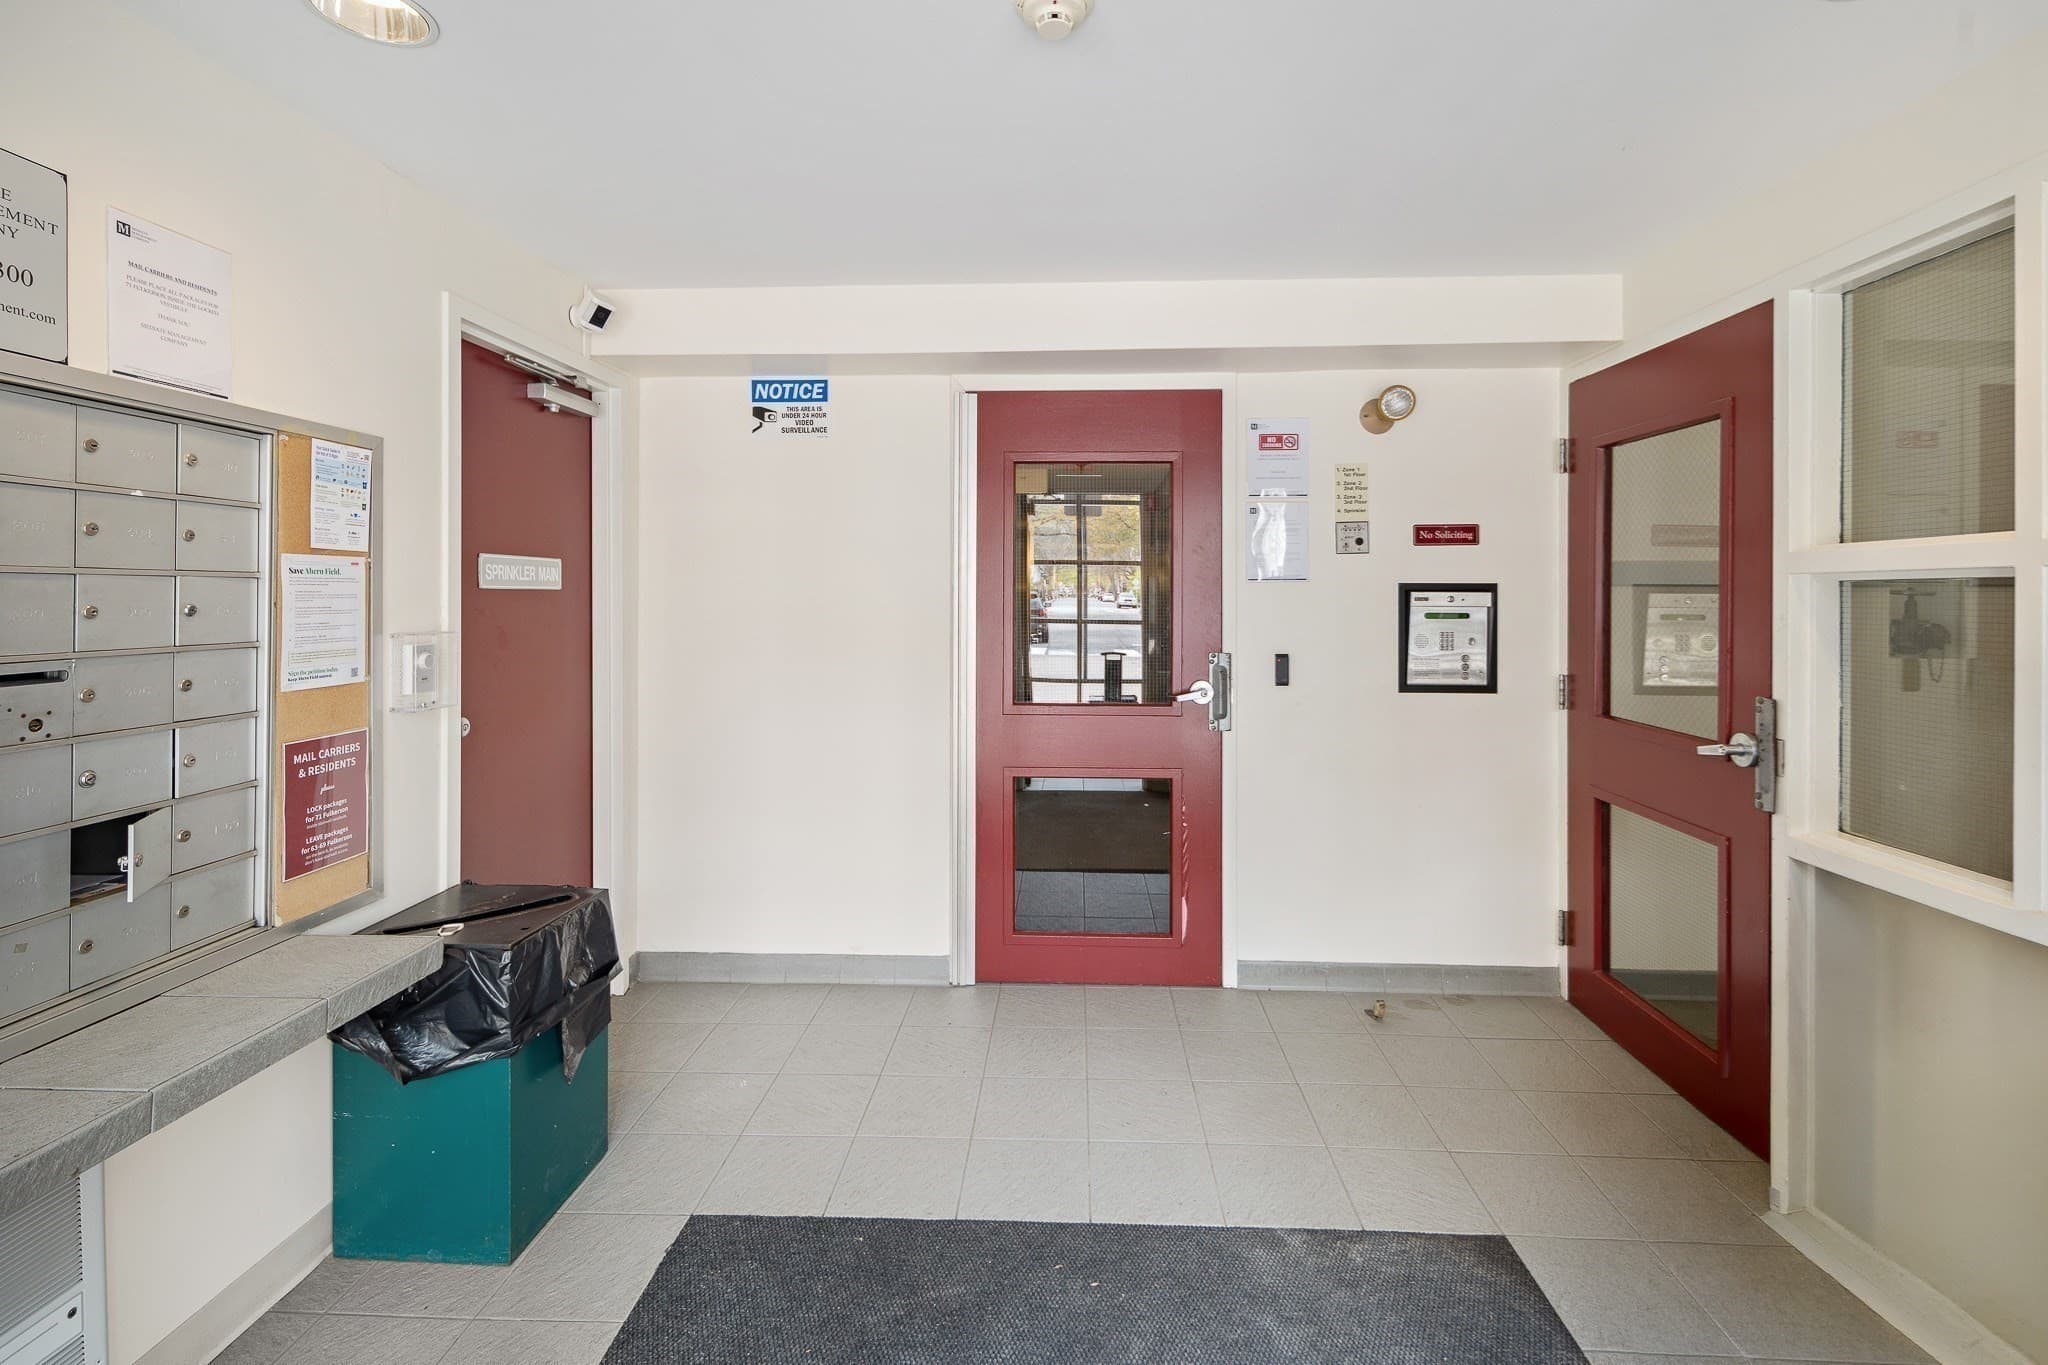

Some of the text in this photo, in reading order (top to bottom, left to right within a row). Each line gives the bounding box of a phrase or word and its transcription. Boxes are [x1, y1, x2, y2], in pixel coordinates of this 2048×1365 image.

[118, 222, 130, 236] M
[128, 260, 218, 297] MAIL CARRIERS AND RESIDENTS
[755, 383, 825, 400] NOTICE
[781, 426, 828, 434] SURVEILLANCE
[1419, 530, 1473, 540] No Soliciting
[288, 567, 304, 575] Save
[485, 564, 559, 582] SPRINKLER MAIN
[293, 742, 361, 765] MAIL CARRIERS
[298, 757, 357, 779] & RESIDENTS
[305, 816, 314, 824] for
[322, 806, 349, 819] Fulkerson
[306, 798, 348, 814] LOCK packages
[305, 826, 349, 845] LEAVE packages
[301, 847, 310, 856] for
[327, 834, 353, 847] Fulkerson
